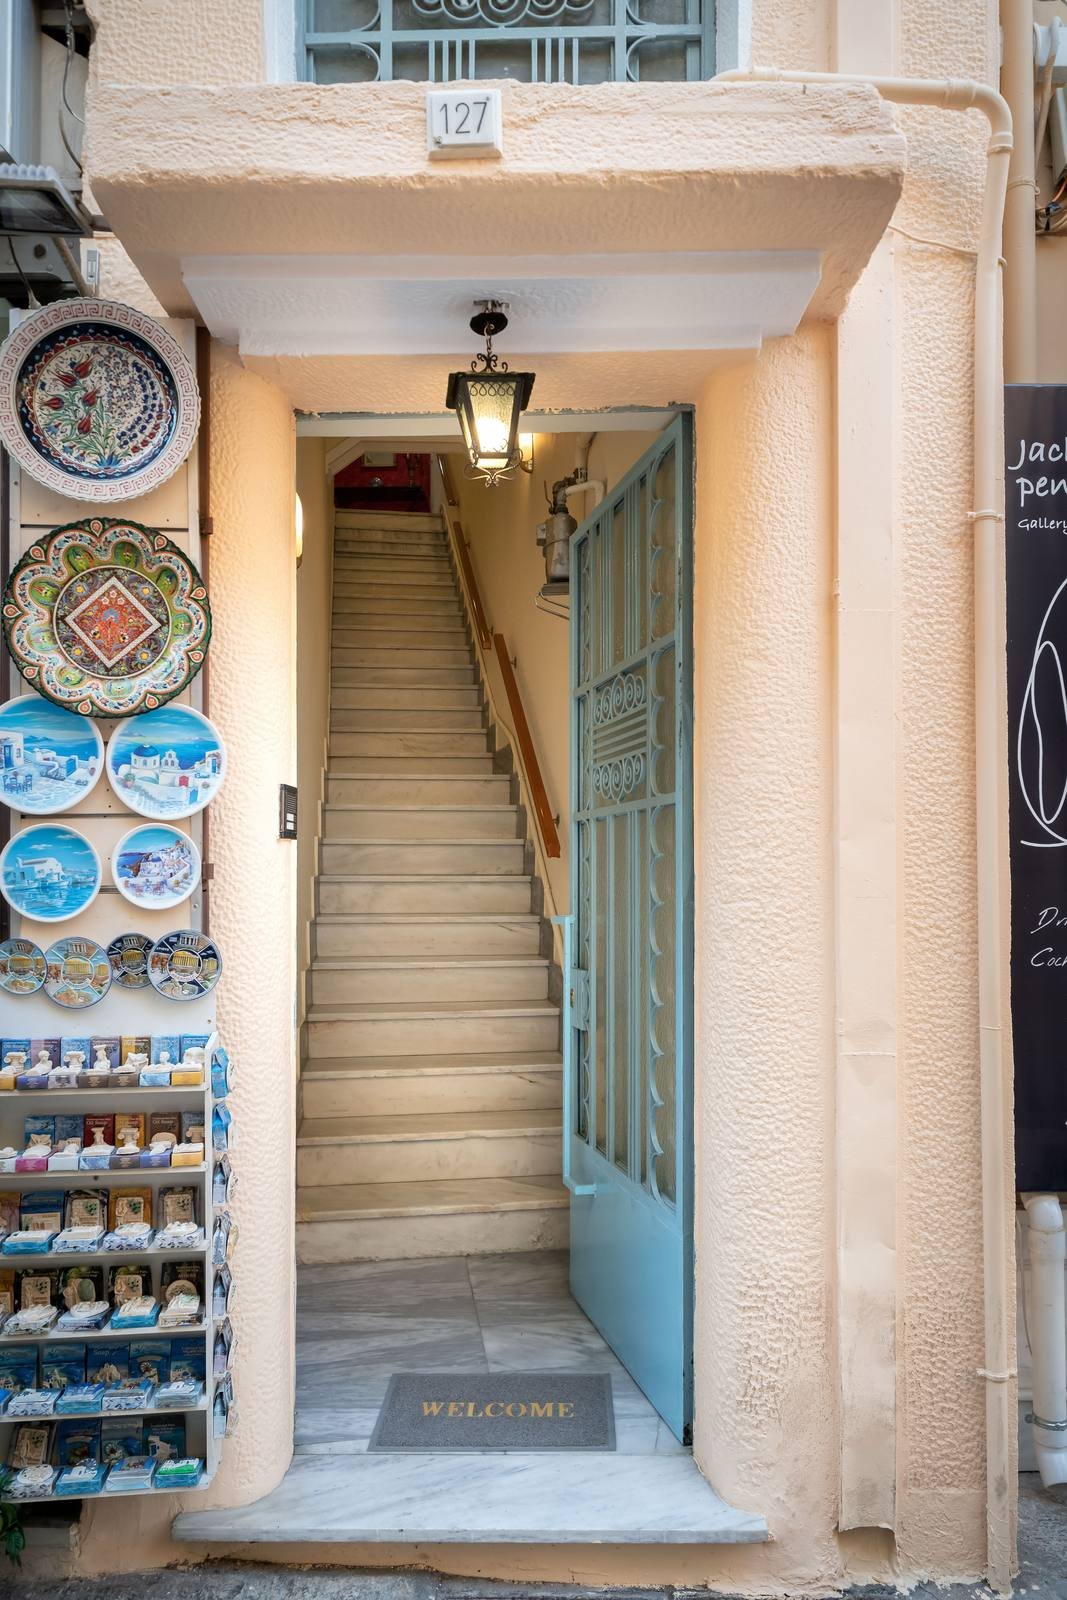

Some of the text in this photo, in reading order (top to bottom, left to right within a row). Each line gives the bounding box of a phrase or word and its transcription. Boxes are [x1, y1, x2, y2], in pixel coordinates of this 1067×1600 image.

[439, 101, 488, 134] 127
[1030, 906, 1067, 934] Dr
[421, 1401, 576, 1418] WELCOME
